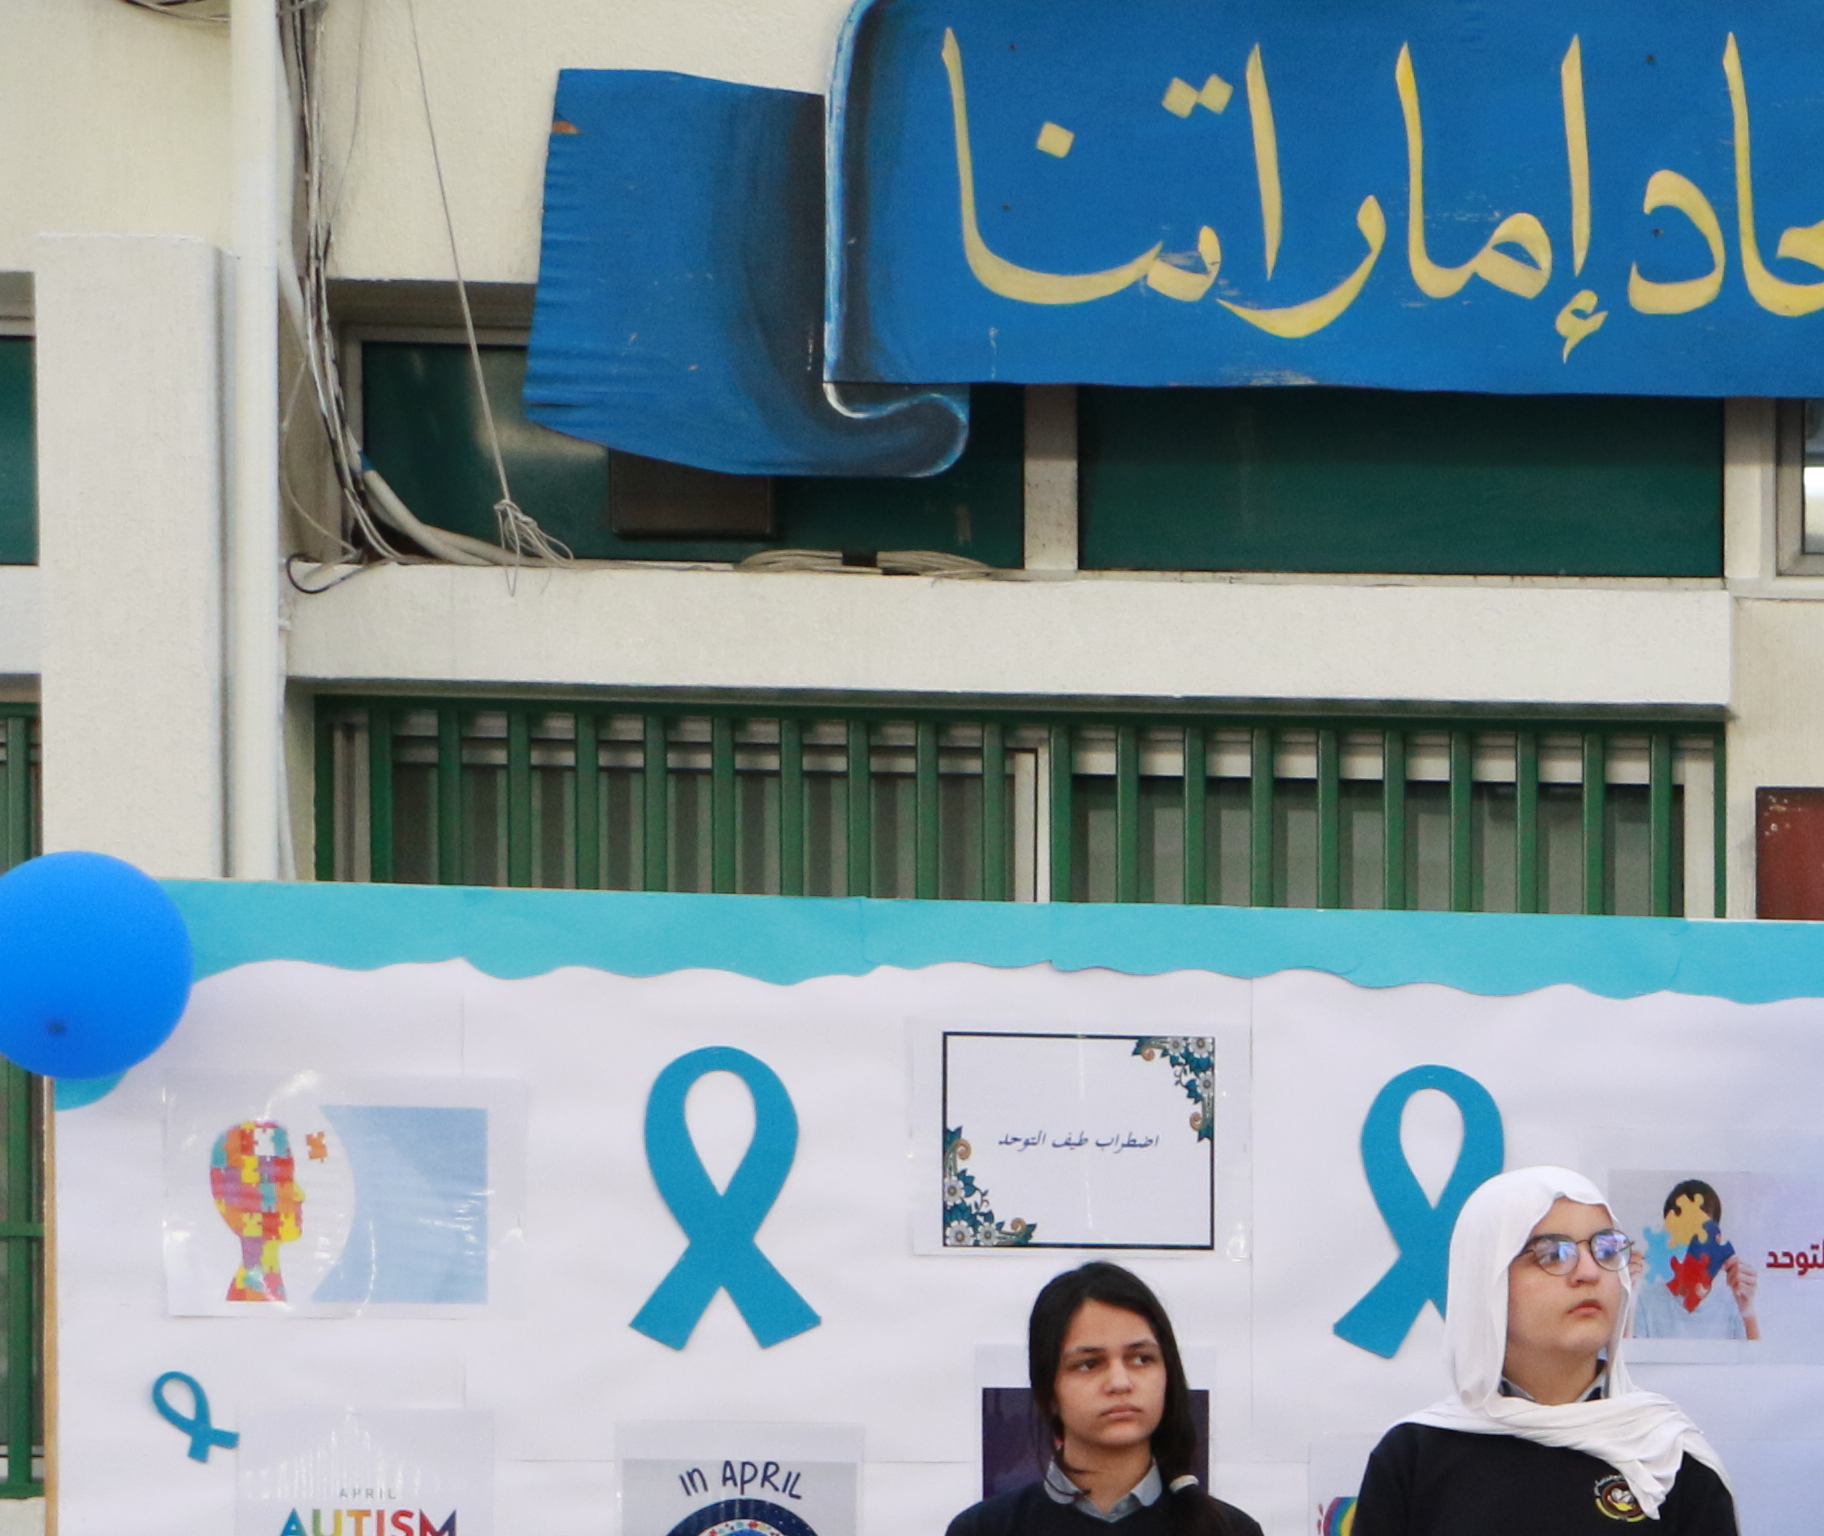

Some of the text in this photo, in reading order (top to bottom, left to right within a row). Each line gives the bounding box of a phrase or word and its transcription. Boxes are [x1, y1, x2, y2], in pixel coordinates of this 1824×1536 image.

[941, 27, 1609, 364] إماراتنا
[998, 1129, 1160, 1154] اضطراب طيف التوحد
[339, 1487, 397, 1500] APRIL
[721, 1460, 803, 1500] APRIL
